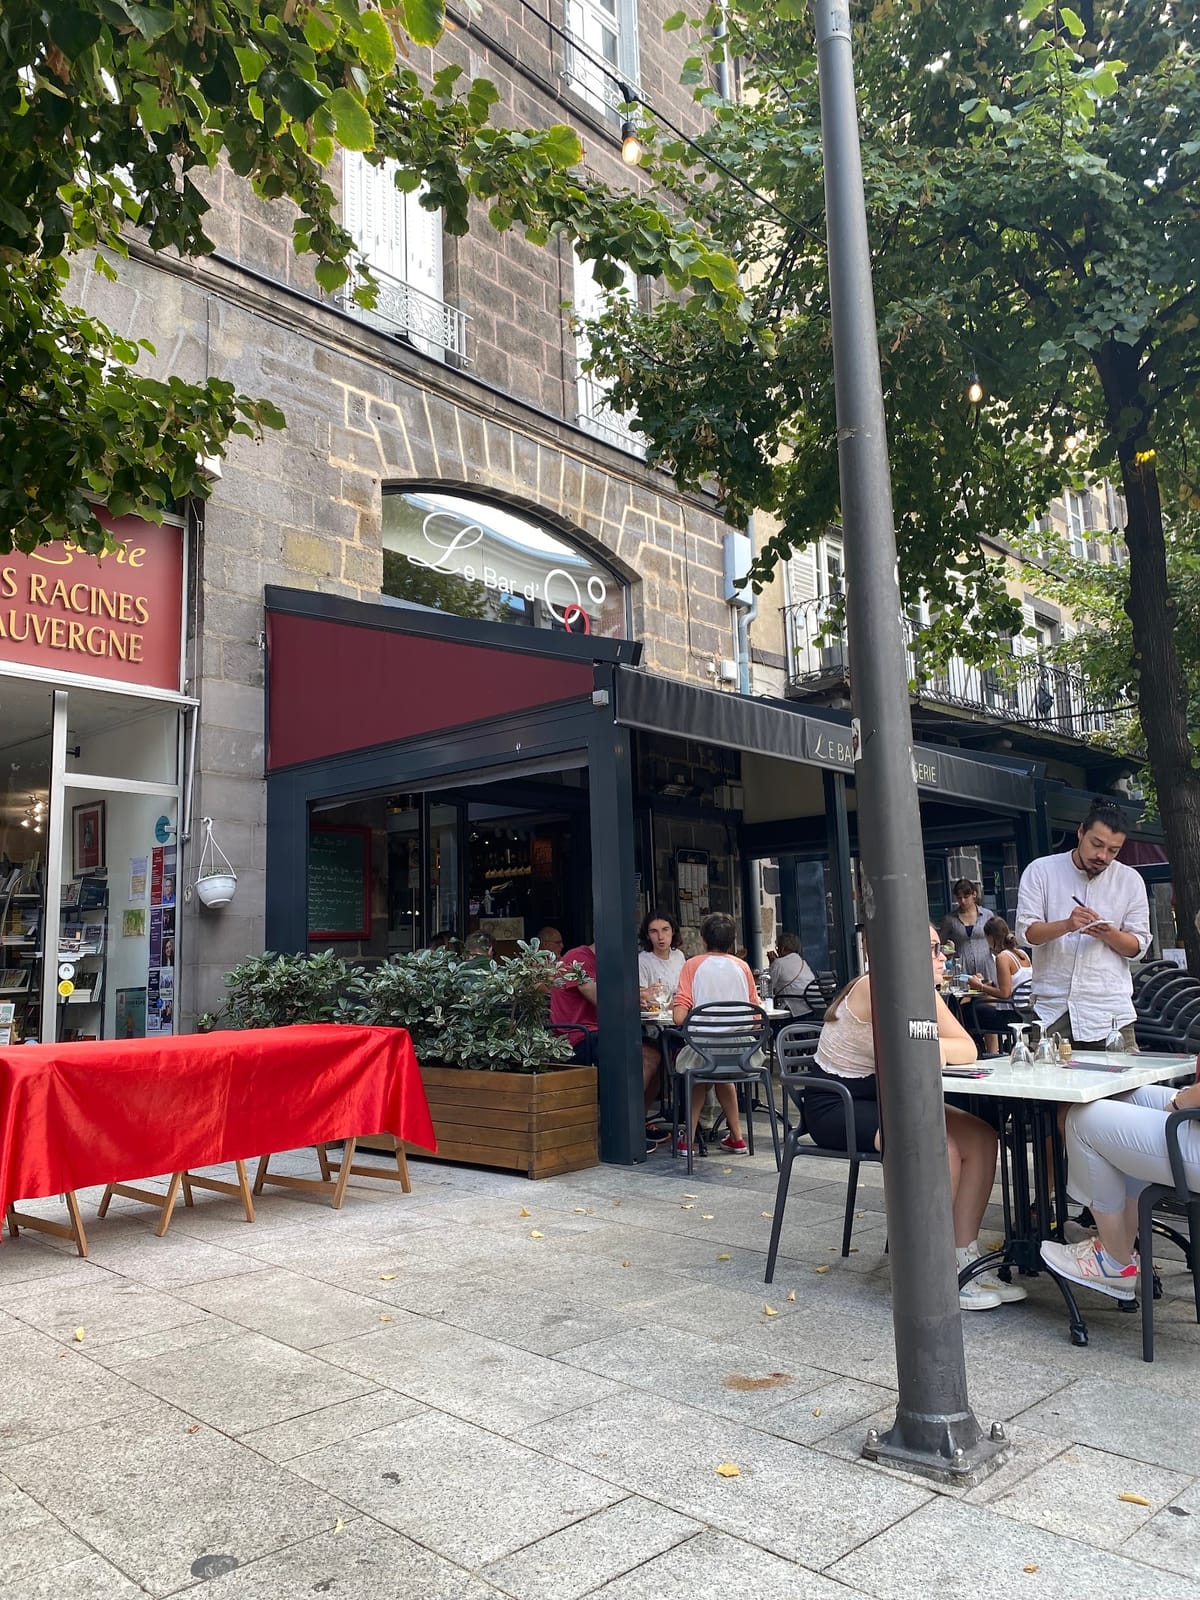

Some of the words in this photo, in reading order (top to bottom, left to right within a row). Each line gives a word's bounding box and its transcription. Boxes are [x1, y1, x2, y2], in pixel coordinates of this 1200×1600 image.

[407, 512, 484, 582] Le
[483, 566, 517, 596] Bar
[30, 573, 150, 625] RACINES
